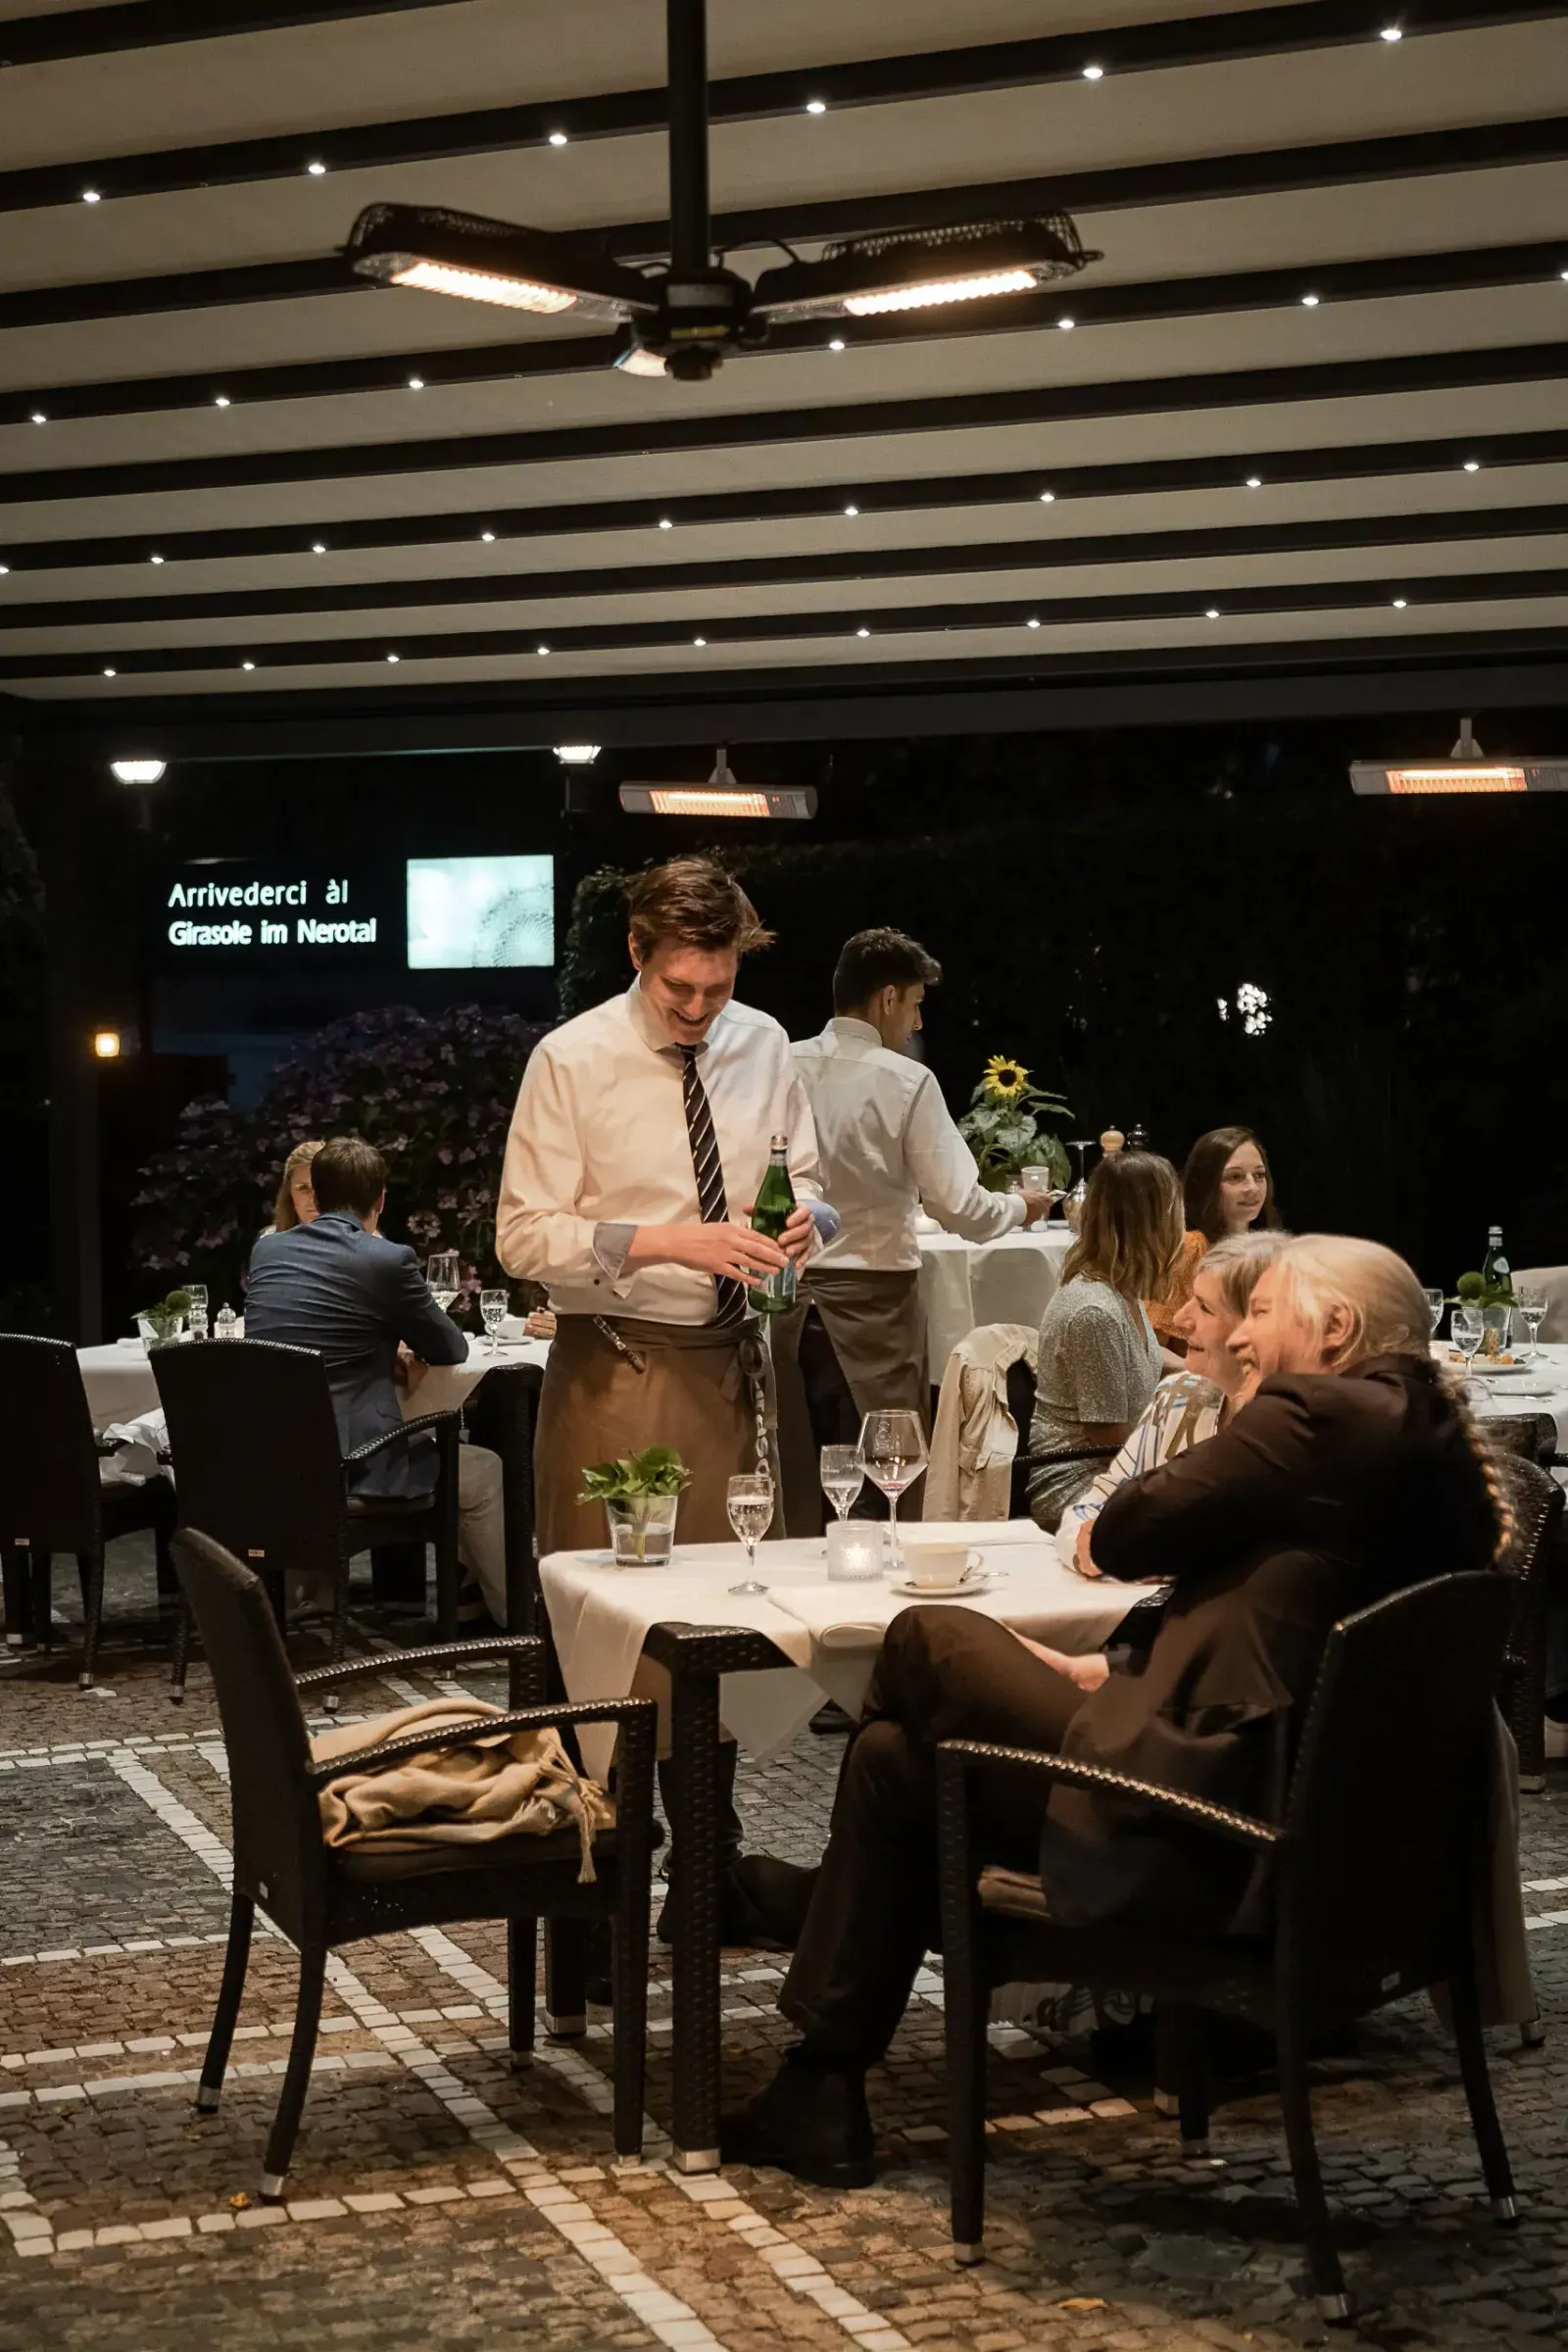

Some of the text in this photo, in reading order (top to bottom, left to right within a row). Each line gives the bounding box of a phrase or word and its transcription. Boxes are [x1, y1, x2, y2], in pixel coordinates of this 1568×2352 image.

[168, 880, 307, 907] Arrivederci
[168, 917, 377, 946] Girasole im Nerotal
